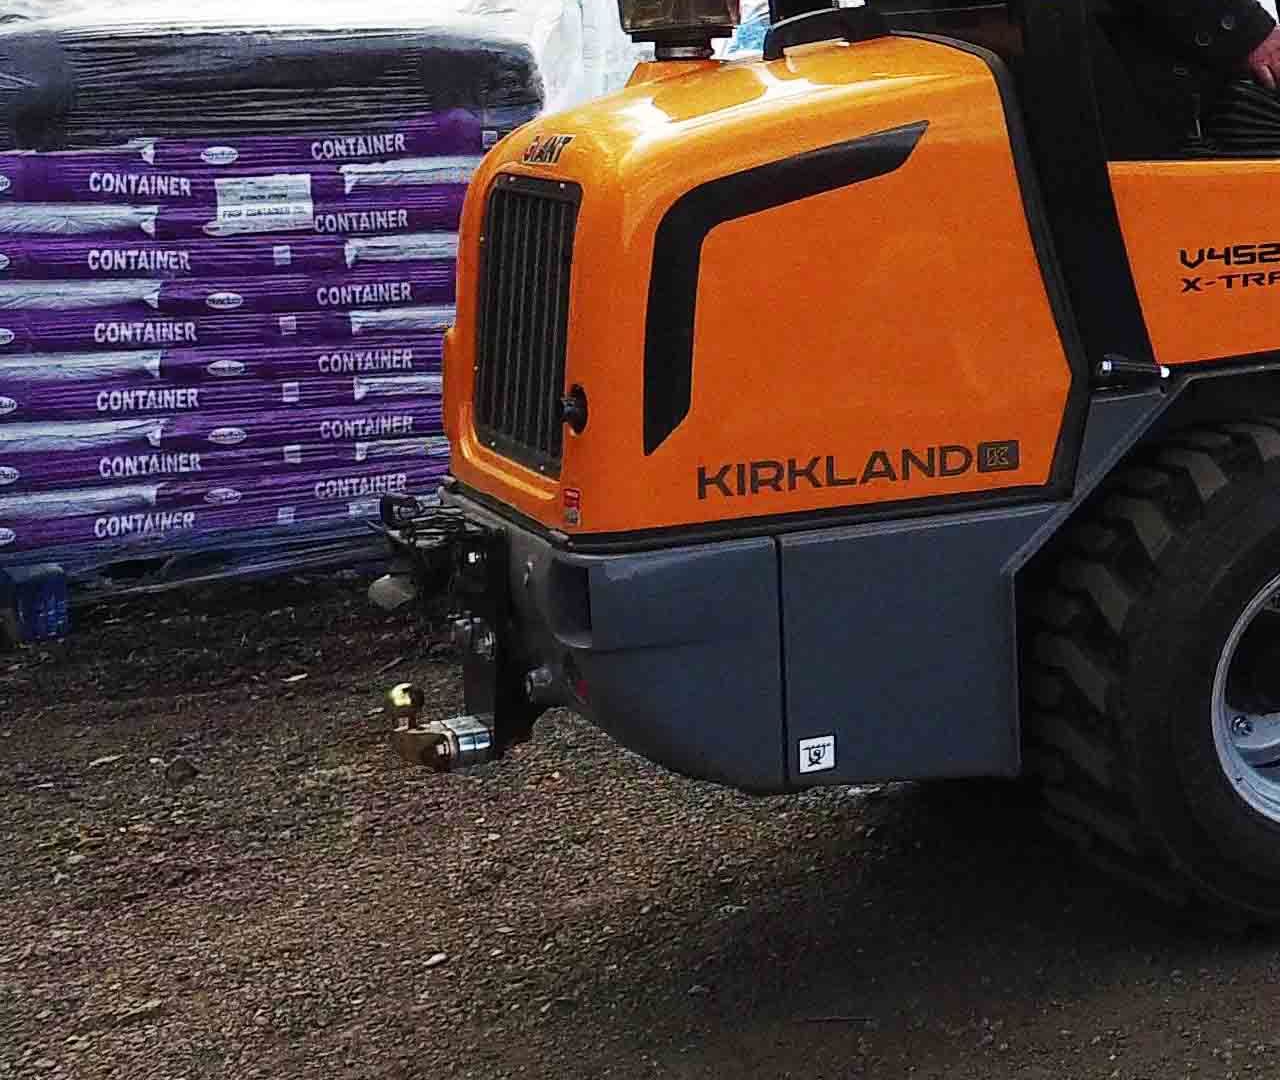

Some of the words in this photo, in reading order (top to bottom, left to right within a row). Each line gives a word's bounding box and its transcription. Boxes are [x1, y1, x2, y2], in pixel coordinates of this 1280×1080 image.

[311, 133, 406, 161] CONTAINER
[88, 171, 192, 197] CONTAINER
[314, 209, 409, 233] CONTAINER
[87, 249, 192, 271] CONTAINER
[316, 281, 413, 306] CONTAINER
[94, 321, 198, 343] CONTAINER
[318, 348, 413, 373] CONTAINER
[96, 388, 200, 411] CONTAINER
[319, 415, 414, 439] CONTAINER
[99, 453, 201, 477] CONTAINER
[697, 444, 973, 500] KIRKLAND
[314, 473, 408, 499] CONTAINER
[94, 511, 196, 538] CONTAINER
